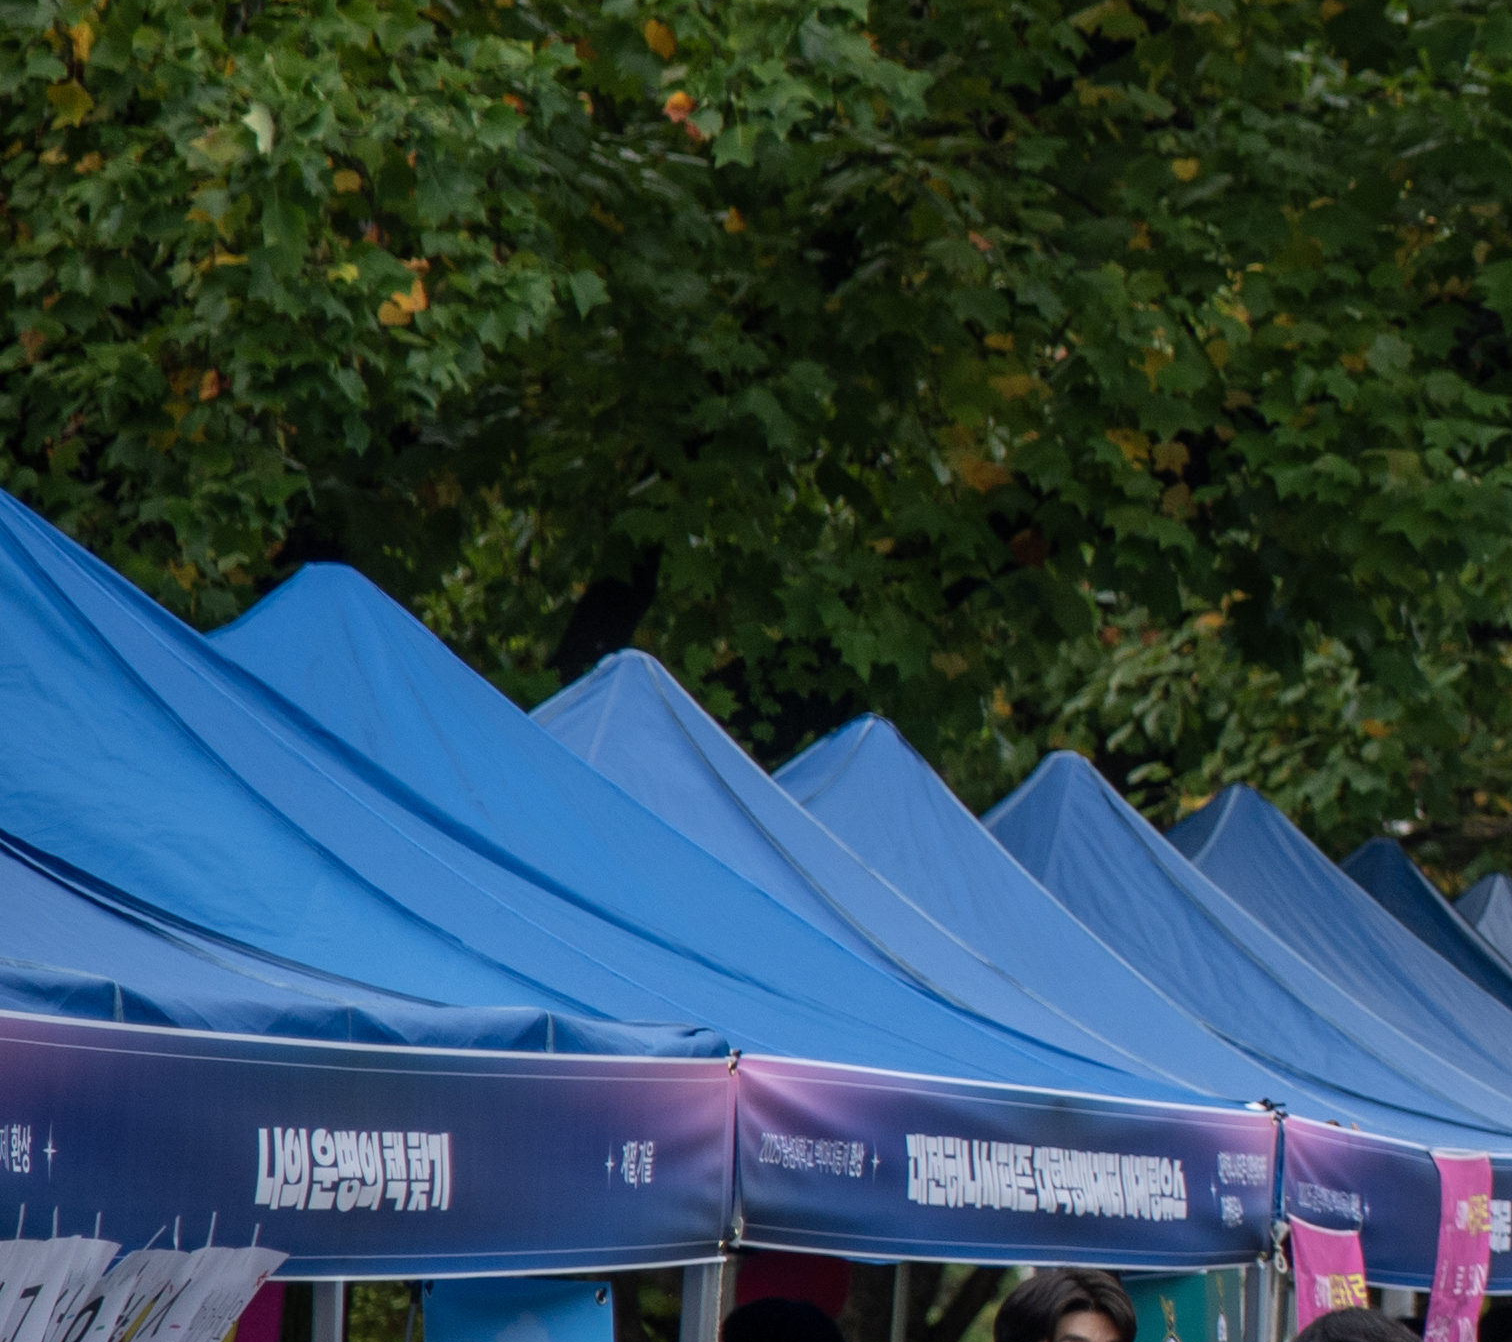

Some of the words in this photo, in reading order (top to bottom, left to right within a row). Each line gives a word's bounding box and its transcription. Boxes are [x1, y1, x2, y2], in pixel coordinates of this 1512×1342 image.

[254, 1126, 310, 1211] 나의
[307, 1127, 384, 1212] 운명의
[406, 1131, 451, 1212] 찾기
